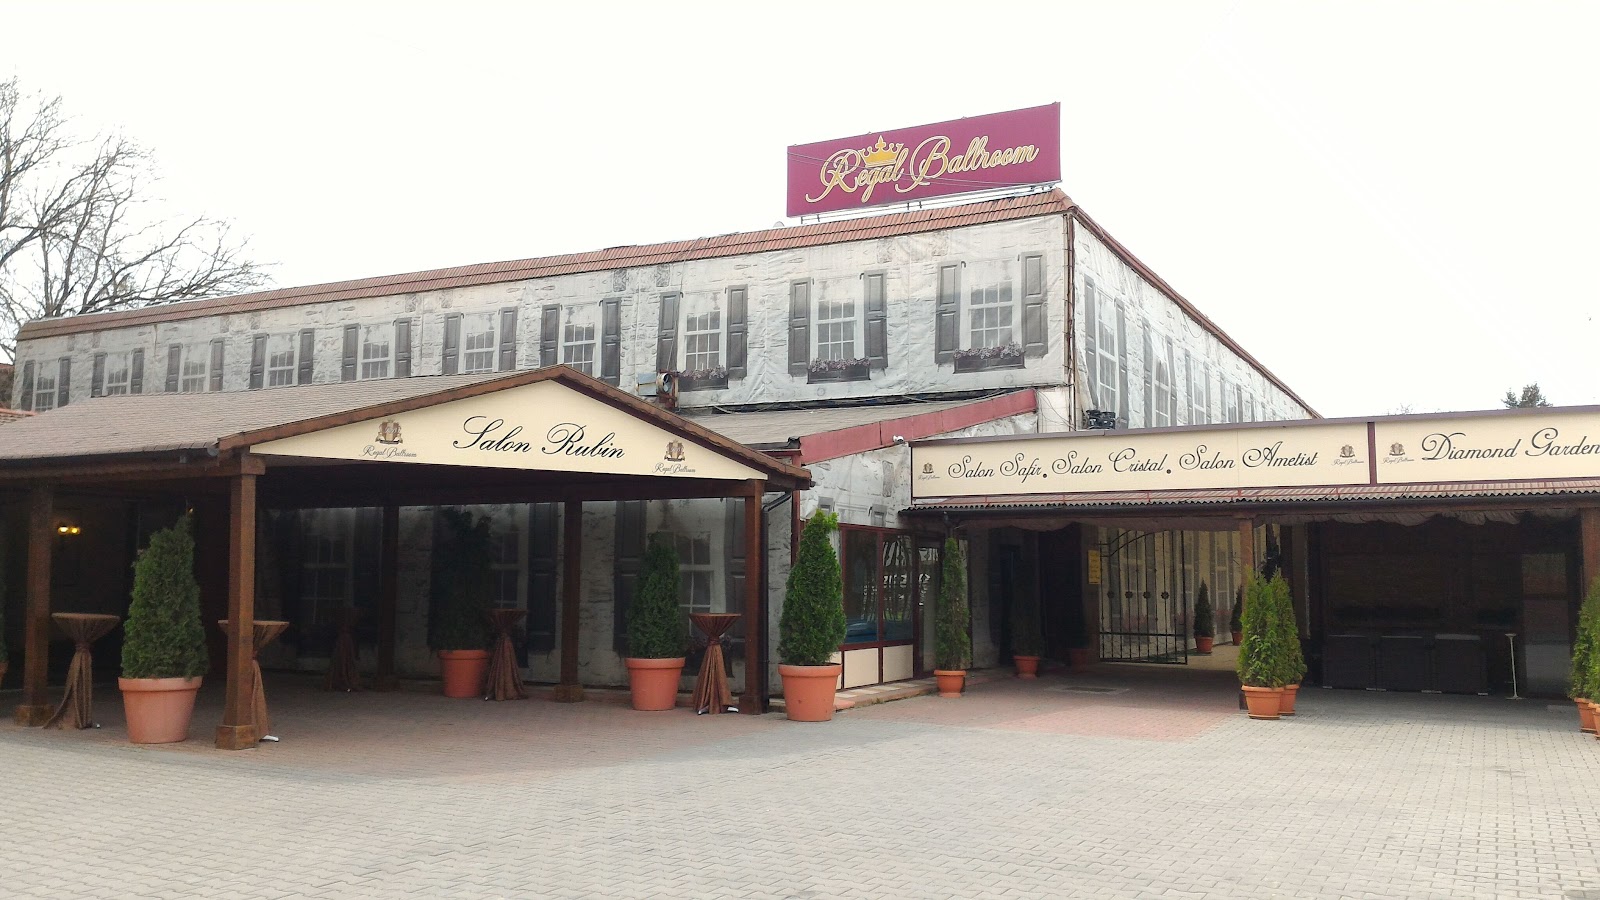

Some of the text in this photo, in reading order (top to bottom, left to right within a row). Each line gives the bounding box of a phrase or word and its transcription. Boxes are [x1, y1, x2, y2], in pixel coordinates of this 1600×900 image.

[805, 135, 1040, 203] Regal Ballroom
[452, 415, 626, 459] Salon Rubin
[1421, 427, 1600, 461] Diamond Garden
[948, 455, 996, 479] Salon
[1052, 450, 1104, 475] Salon
[1179, 444, 1237, 471] Salon
[1242, 441, 1319, 468] Ametist
